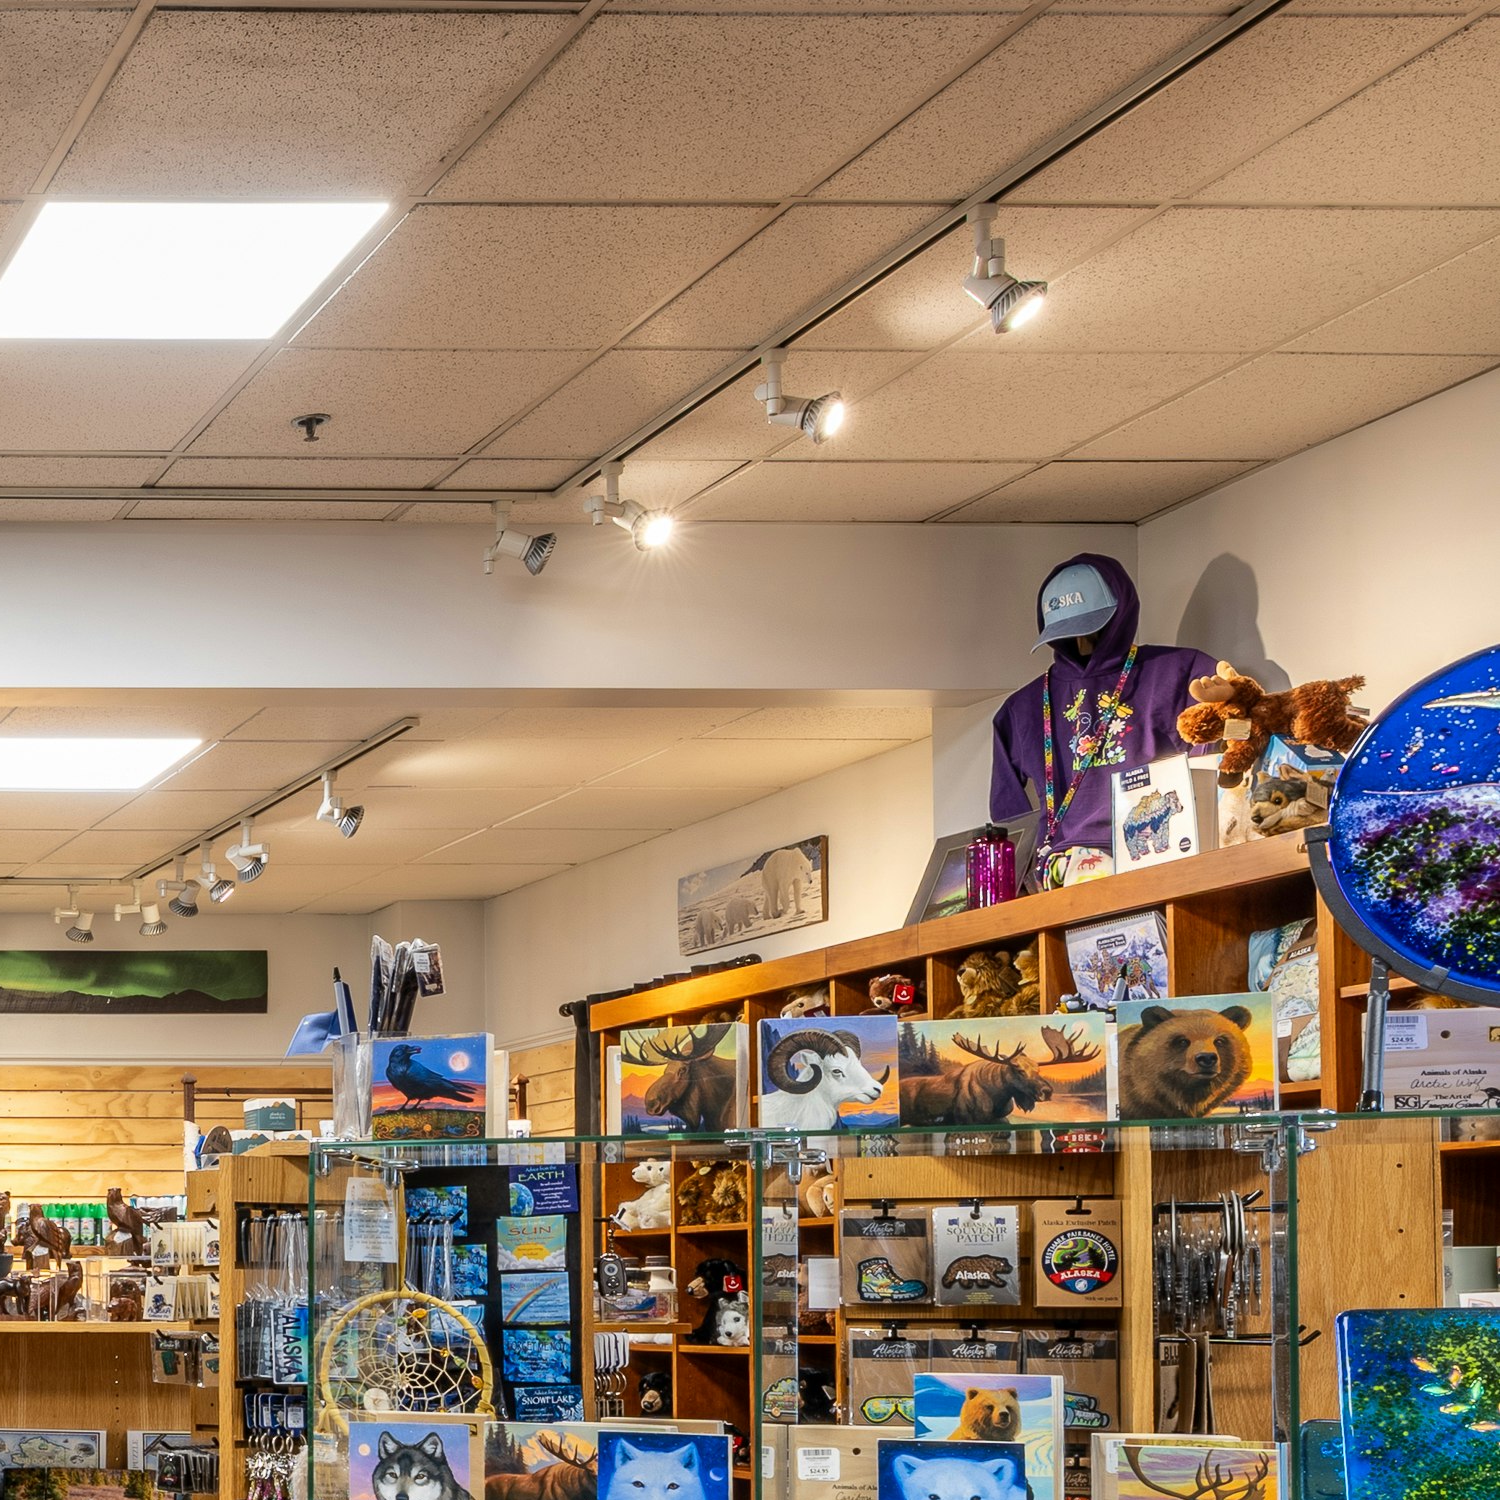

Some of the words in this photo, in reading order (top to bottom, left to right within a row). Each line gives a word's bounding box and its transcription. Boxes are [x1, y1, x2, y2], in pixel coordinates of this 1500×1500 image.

[1126, 767, 1144, 778] ALASKA
[1410, 1078, 1452, 1089] Arctic
[1456, 1077, 1484, 1092] Wolf
[947, 1228, 1008, 1236] SOUVENIR
[1044, 1235, 1064, 1265] WESTMARK
[1066, 1230, 1104, 1246] FAIRBANKS
[1104, 1241, 1116, 1261] HOTEL
[956, 1270, 990, 1280] Alaska
[1060, 1268, 1100, 1280] ALASKA
[282, 1315, 303, 1381] ALASKA
